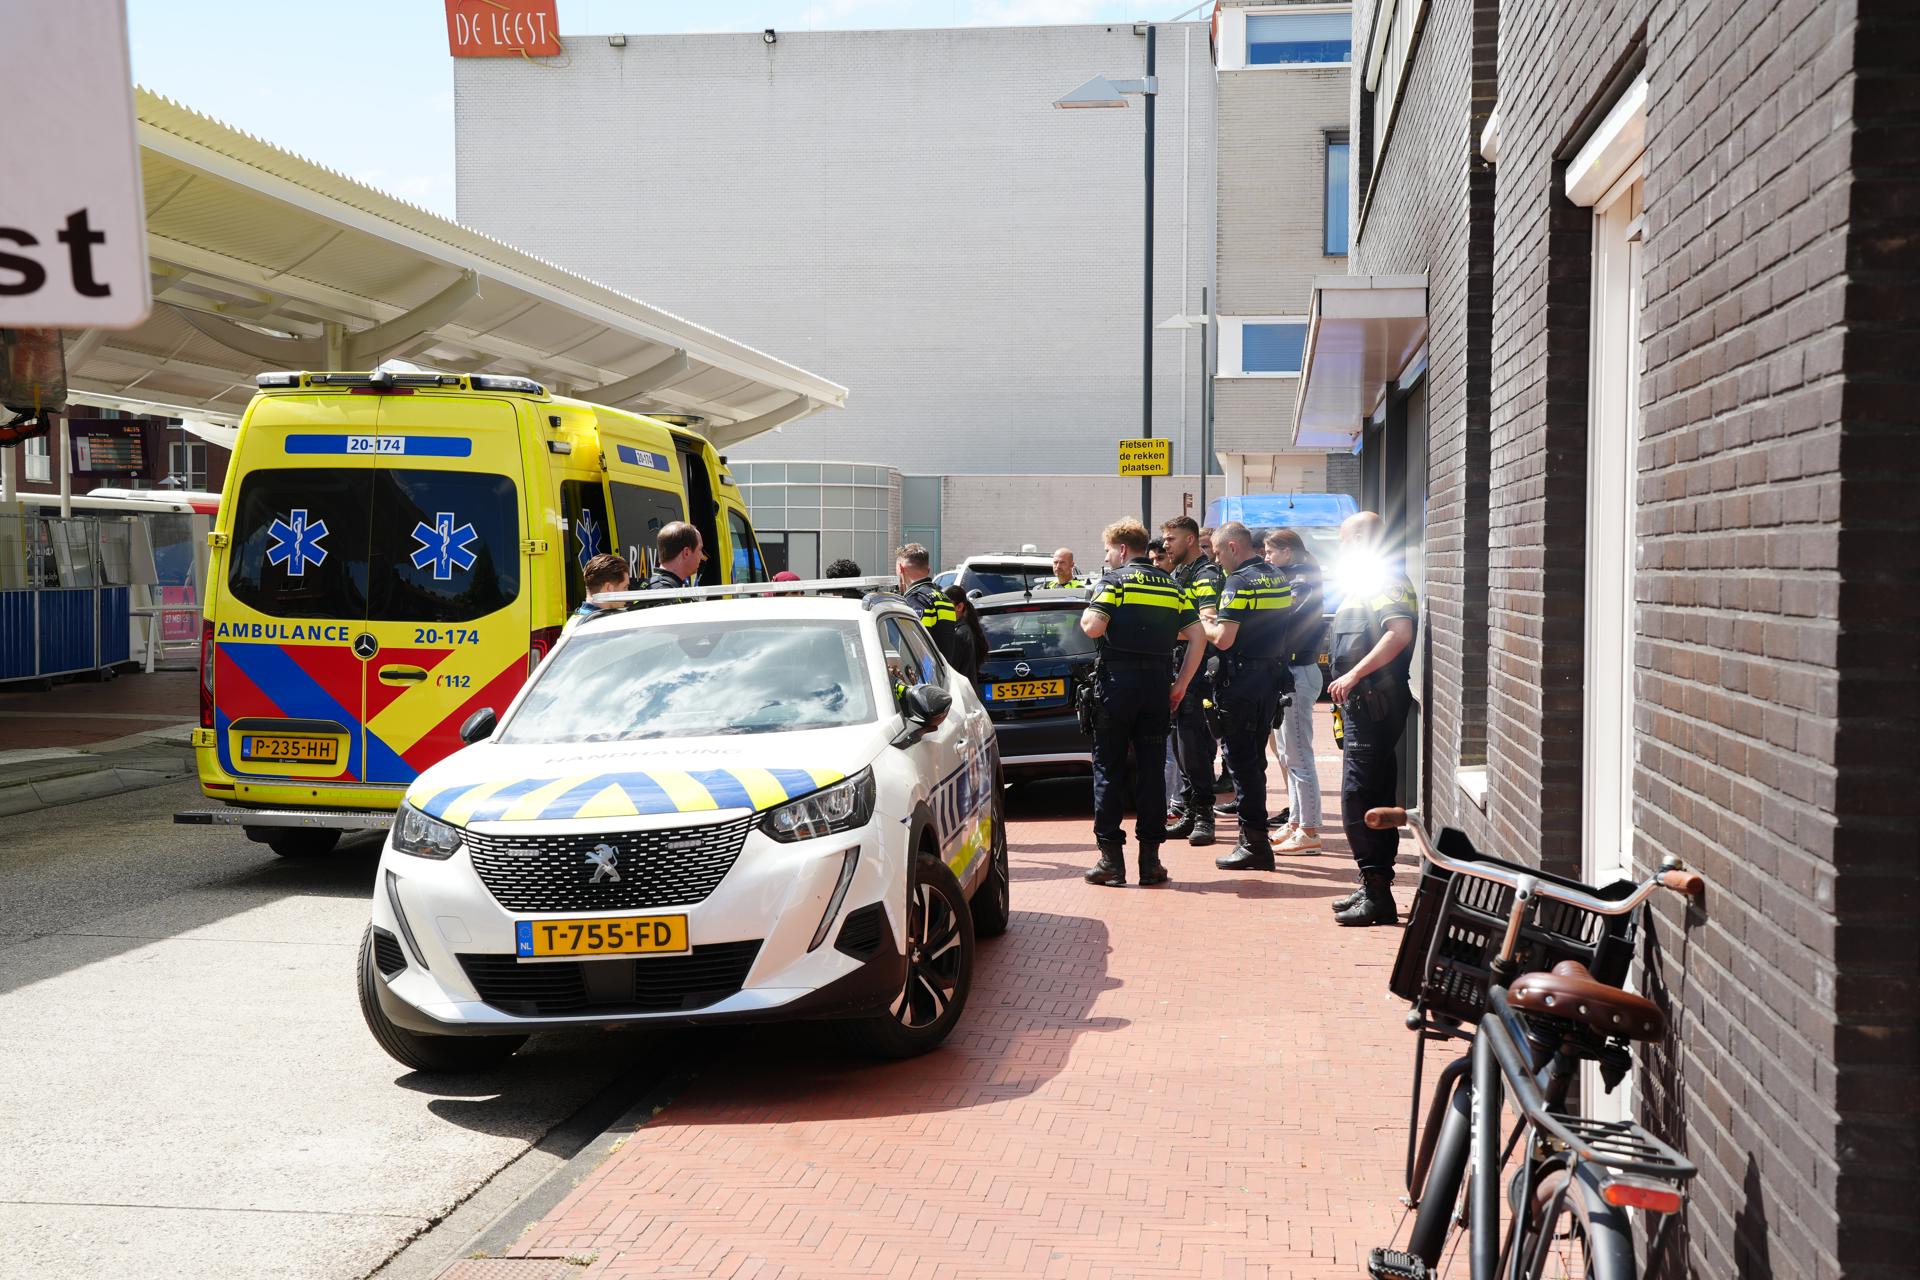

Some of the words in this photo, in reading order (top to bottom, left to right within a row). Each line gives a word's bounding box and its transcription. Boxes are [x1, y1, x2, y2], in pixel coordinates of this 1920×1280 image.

[455, 12, 482, 46] DE
[491, 12, 547, 45] LEEST
[351, 438, 400, 451] 20-174
[1120, 440, 1153, 449] Fietsen
[1156, 440, 1165, 448] in
[1120, 452, 1131, 460] de
[1133, 451, 1165, 460] rekken
[1122, 463, 1164, 473] plaatsen.
[217, 622, 349, 642] AMBULANCE
[414, 628, 480, 645] 20-174
[997, 681, 1058, 698] S-572-SZ
[256, 740, 330, 757] P-235-HH
[520, 942, 532, 950] NL
[542, 920, 672, 951] T-755-FD
